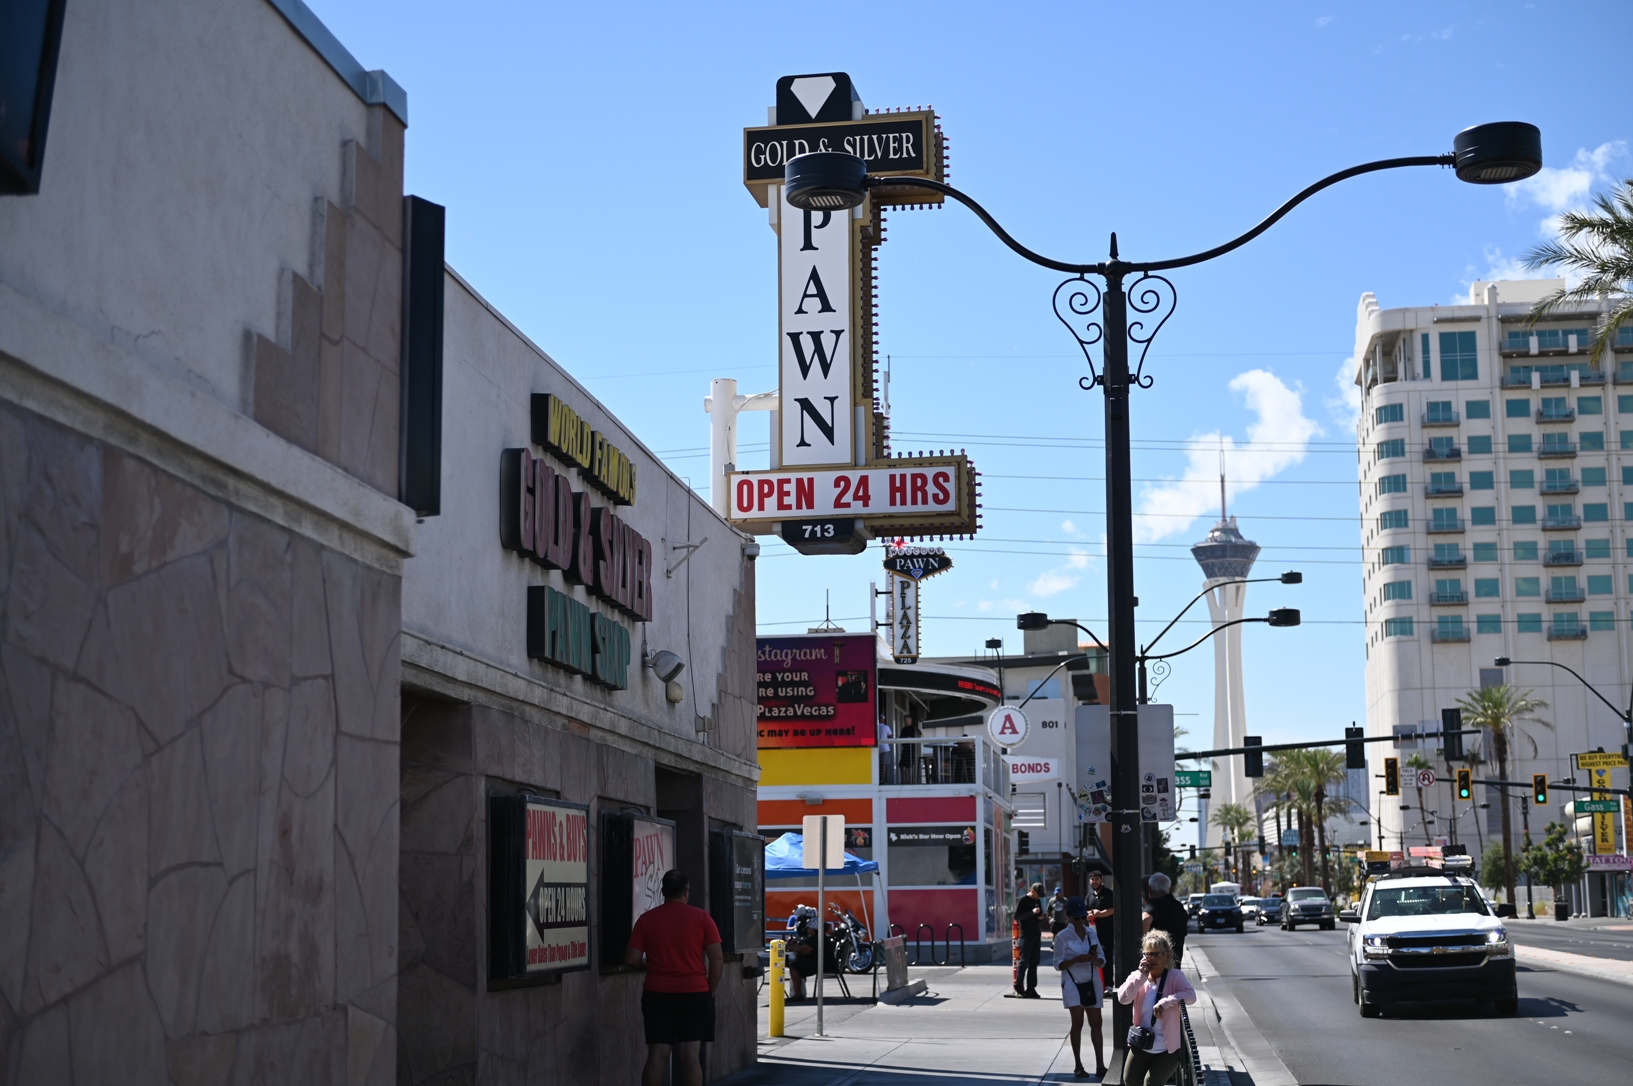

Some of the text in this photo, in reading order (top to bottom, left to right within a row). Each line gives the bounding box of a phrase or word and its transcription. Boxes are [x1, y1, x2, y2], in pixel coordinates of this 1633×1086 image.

[751, 139, 810, 167] GOLD
[843, 132, 917, 161] SILVER
[786, 209, 845, 448] PAWN
[549, 393, 636, 506] WORLD FAMOUS
[736, 471, 951, 513] OPEN 24 HRS
[520, 447, 653, 622] GOLD & SILVER
[802, 524, 835, 538] 713
[890, 547, 943, 556] WELCOME
[895, 557, 940, 570] PAWN
[899, 580, 913, 654] PLAZA
[544, 585, 631, 690] PAWN SHOP
[998, 713, 1020, 735] A
[1041, 720, 1058, 729] 801
[1011, 762, 1051, 774] BONDS
[1584, 802, 1604, 811] Gass
[526, 809, 587, 863] PAWNS & BUYS
[945, 833, 962, 841] Open
[1599, 811, 1609, 844] ILVER
[634, 831, 665, 879] PAWN
[539, 886, 586, 923] OPEN 24 HOURS
